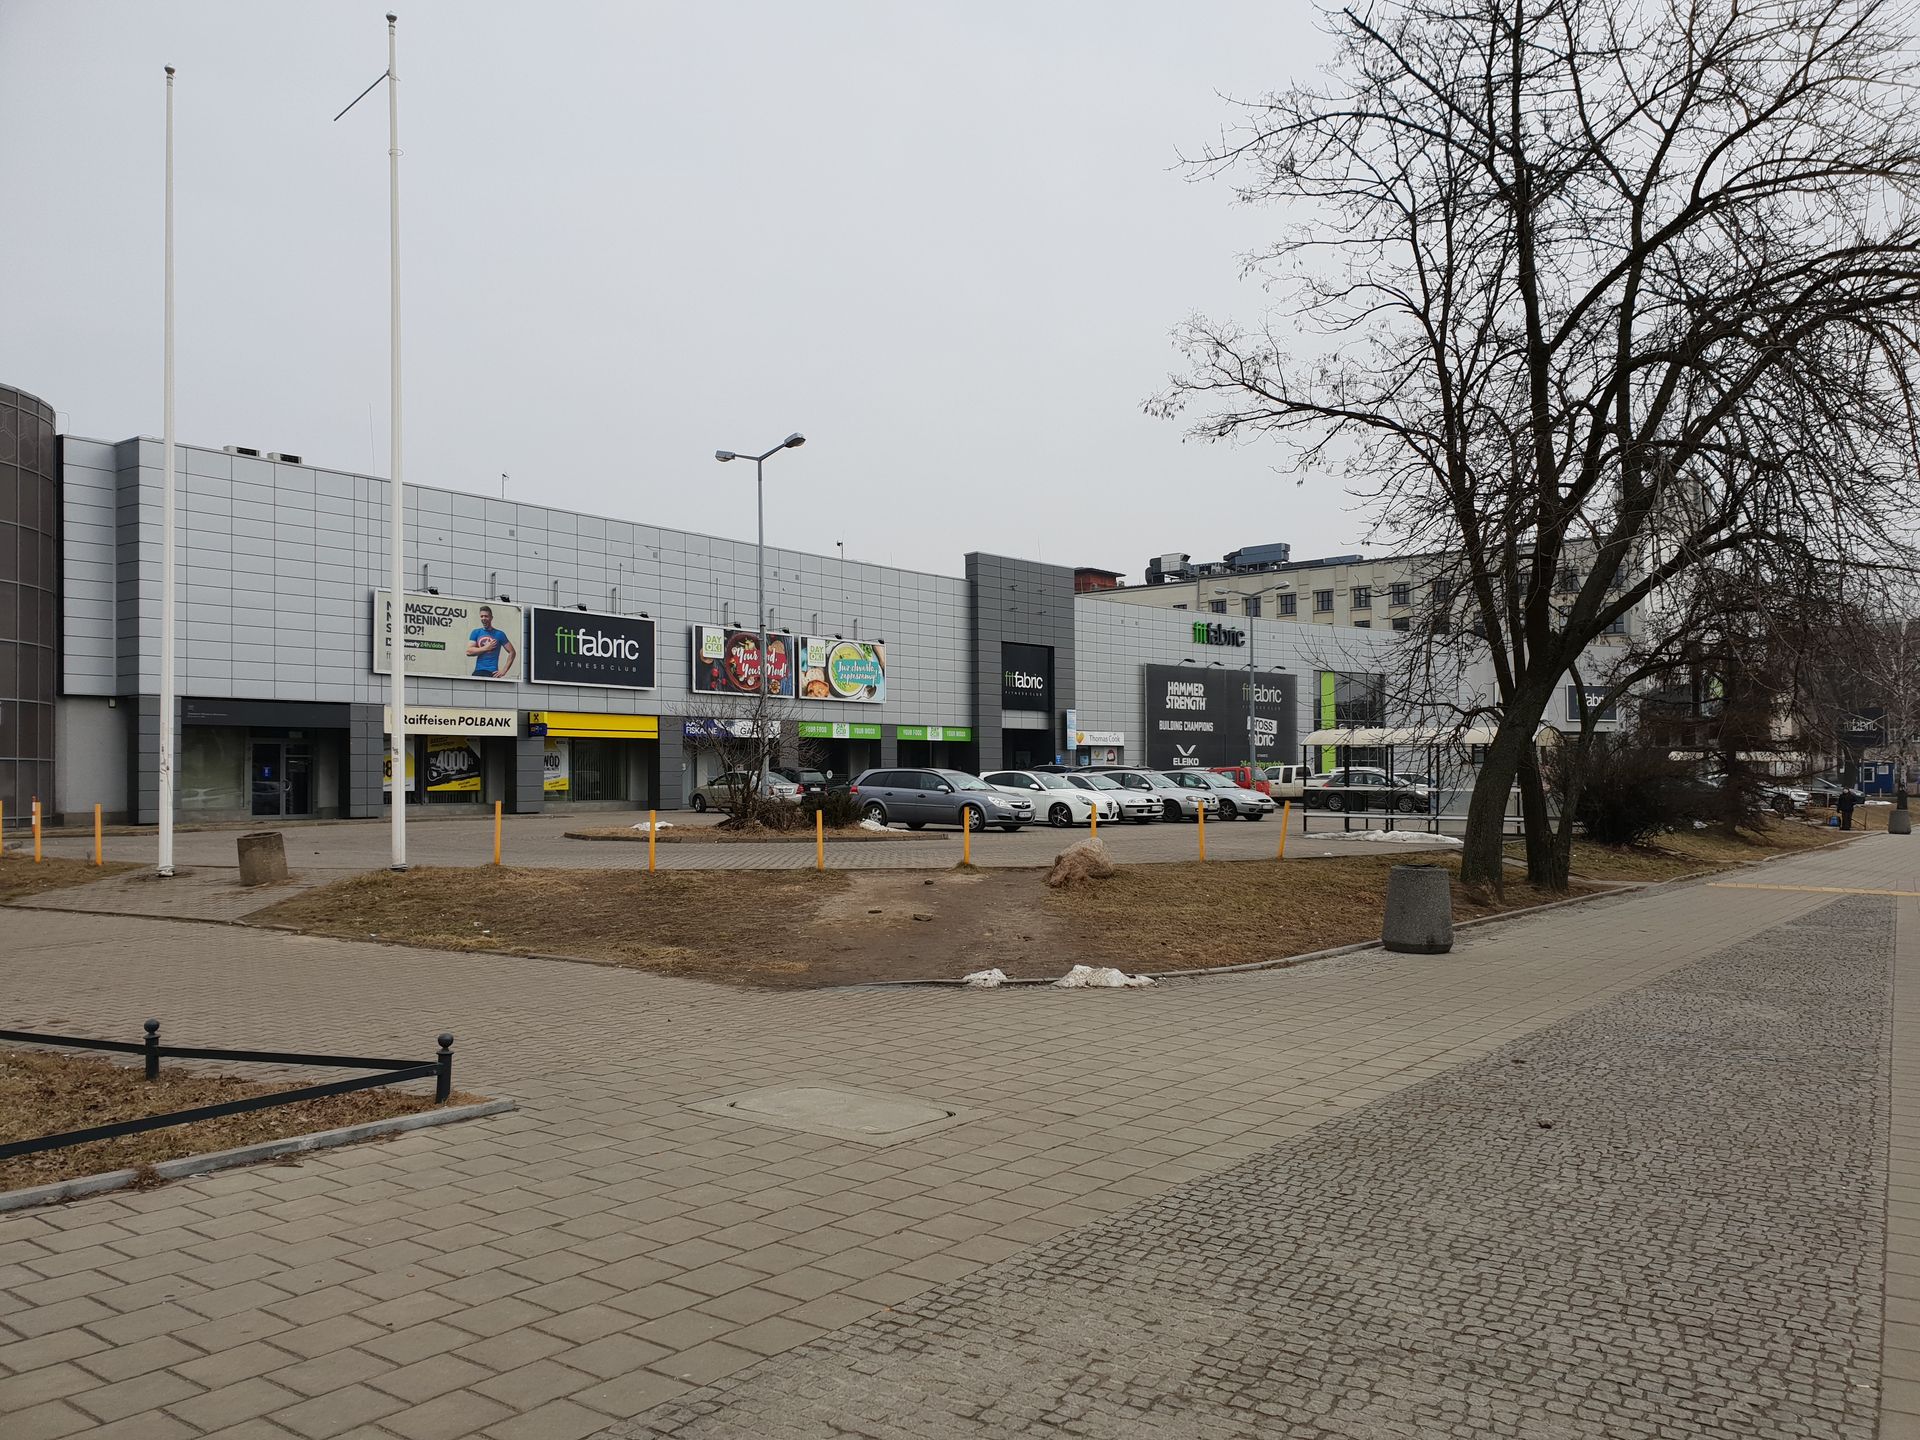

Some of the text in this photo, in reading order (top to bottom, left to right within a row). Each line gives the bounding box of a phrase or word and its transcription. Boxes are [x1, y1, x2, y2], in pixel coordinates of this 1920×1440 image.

[405, 603, 434, 615] MASZ
[434, 606, 467, 618] CZASU
[404, 613, 453, 628] TRENING?
[706, 635, 722, 643] DAY
[1193, 620, 1246, 648] fitfabric
[555, 626, 640, 660] fitfabric
[810, 645, 824, 654] DAY
[555, 660, 637, 673] FITNESS CLUB
[1005, 670, 1043, 689] fitfabric
[1167, 681, 1205, 697] HAMMER
[1165, 695, 1207, 711] STRENGTH
[457, 716, 512, 728] POLBANK
[1158, 720, 1214, 732] BUILDING CHAMPIONS
[1089, 734, 1120, 743] Thomas Cook
[436, 750, 468, 771] 4000
[1172, 757, 1200, 766] ELEIKO
